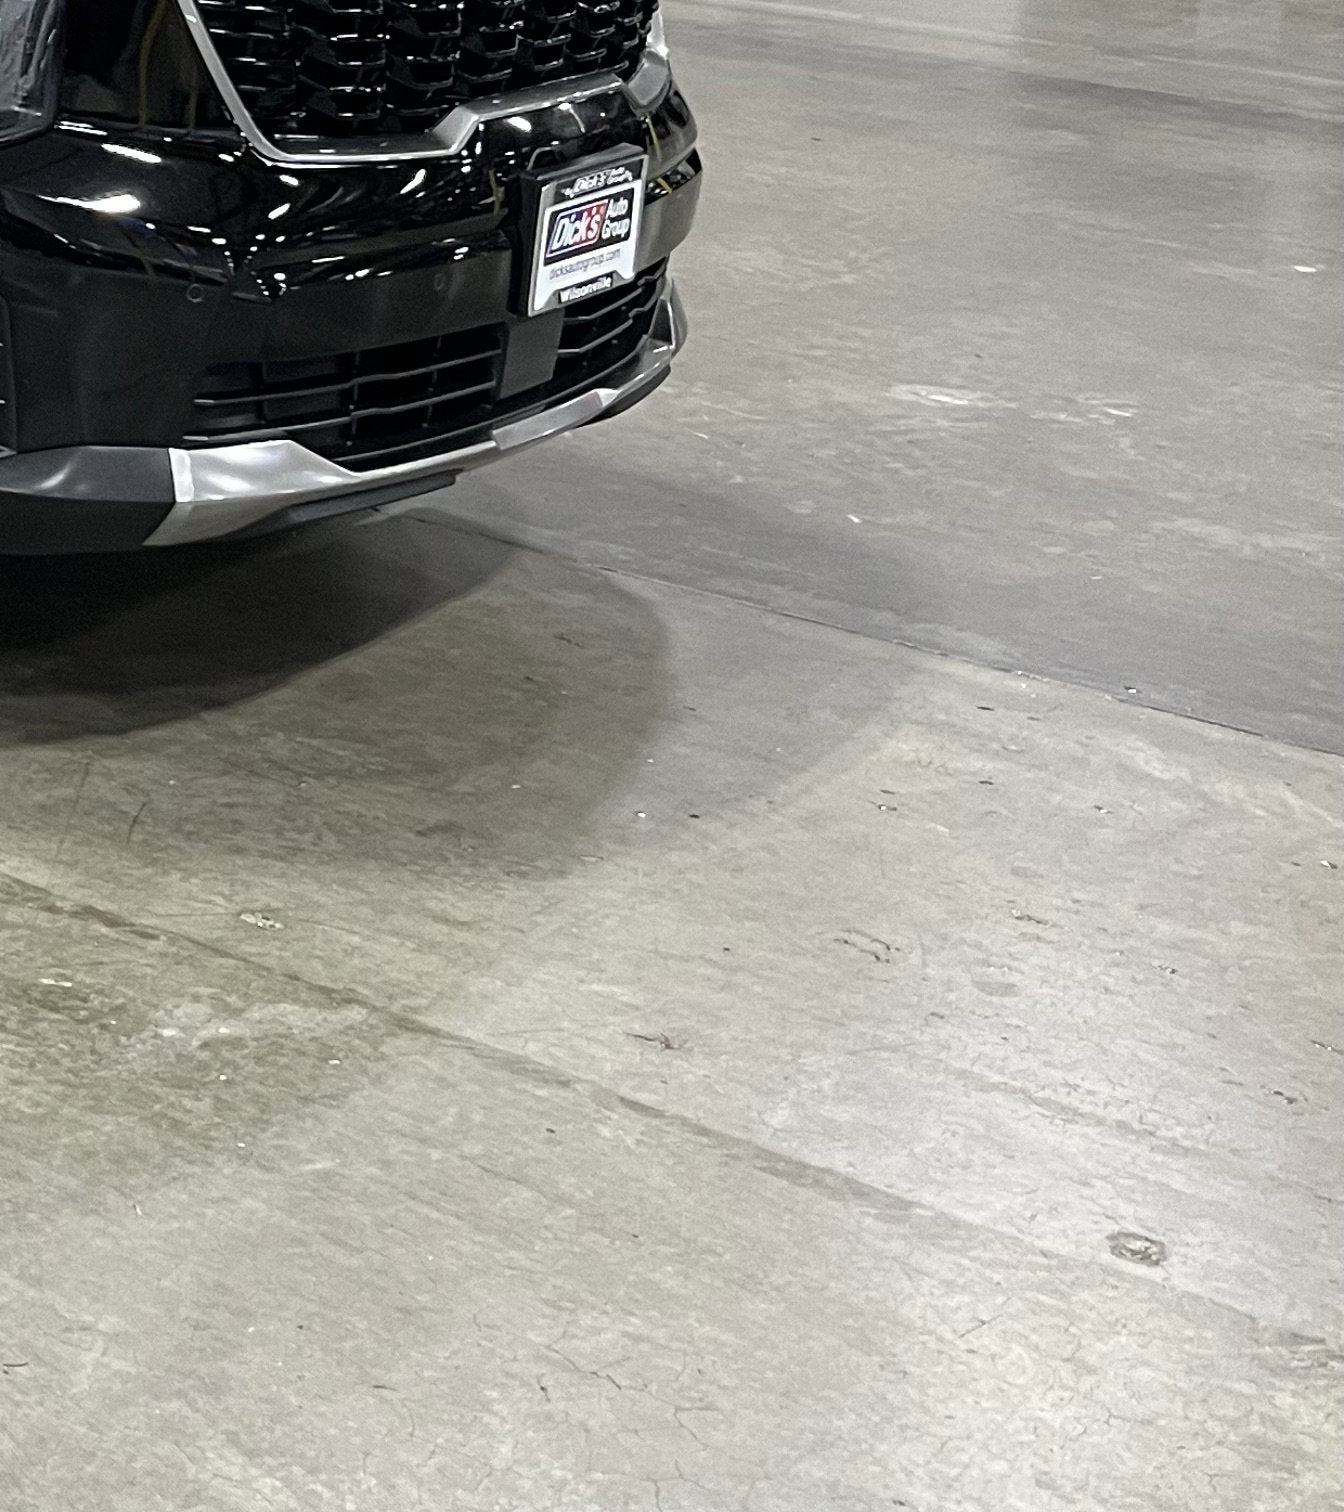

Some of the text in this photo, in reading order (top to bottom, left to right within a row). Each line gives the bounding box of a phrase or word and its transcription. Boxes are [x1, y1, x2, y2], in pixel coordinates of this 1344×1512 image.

[608, 197, 629, 219] Auto
[552, 211, 602, 249] Dick's
[601, 218, 631, 240] Group
[560, 277, 612, 302] Wilsonville
